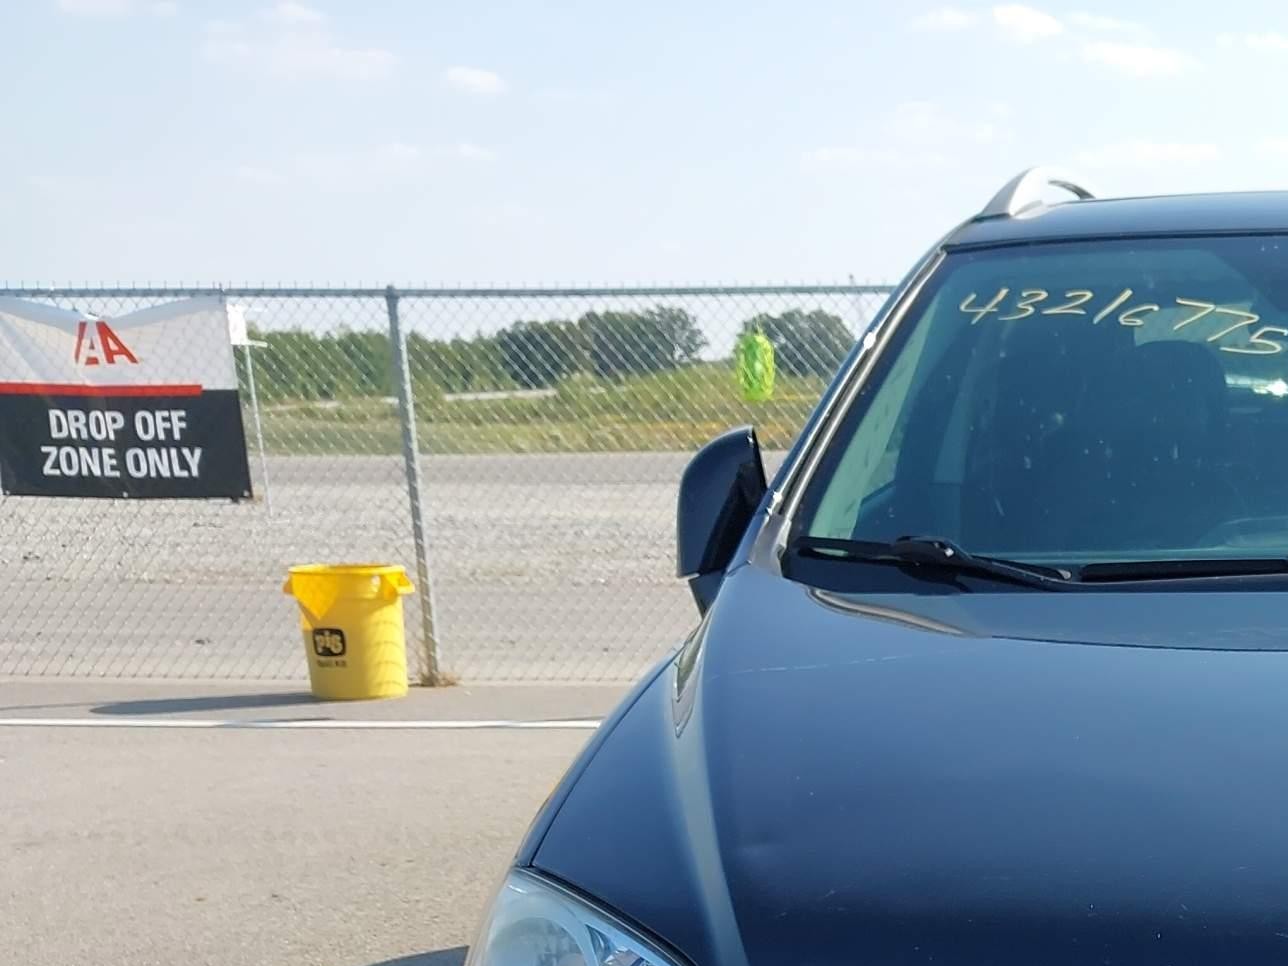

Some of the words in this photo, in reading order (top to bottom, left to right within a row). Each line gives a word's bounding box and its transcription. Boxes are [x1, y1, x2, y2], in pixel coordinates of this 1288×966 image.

[959, 288, 1288, 355] 43216775
[48, 409, 125, 441] DROP
[135, 410, 188, 442] OFF
[41, 446, 121, 478] ZONE
[126, 447, 203, 479] ONLY
